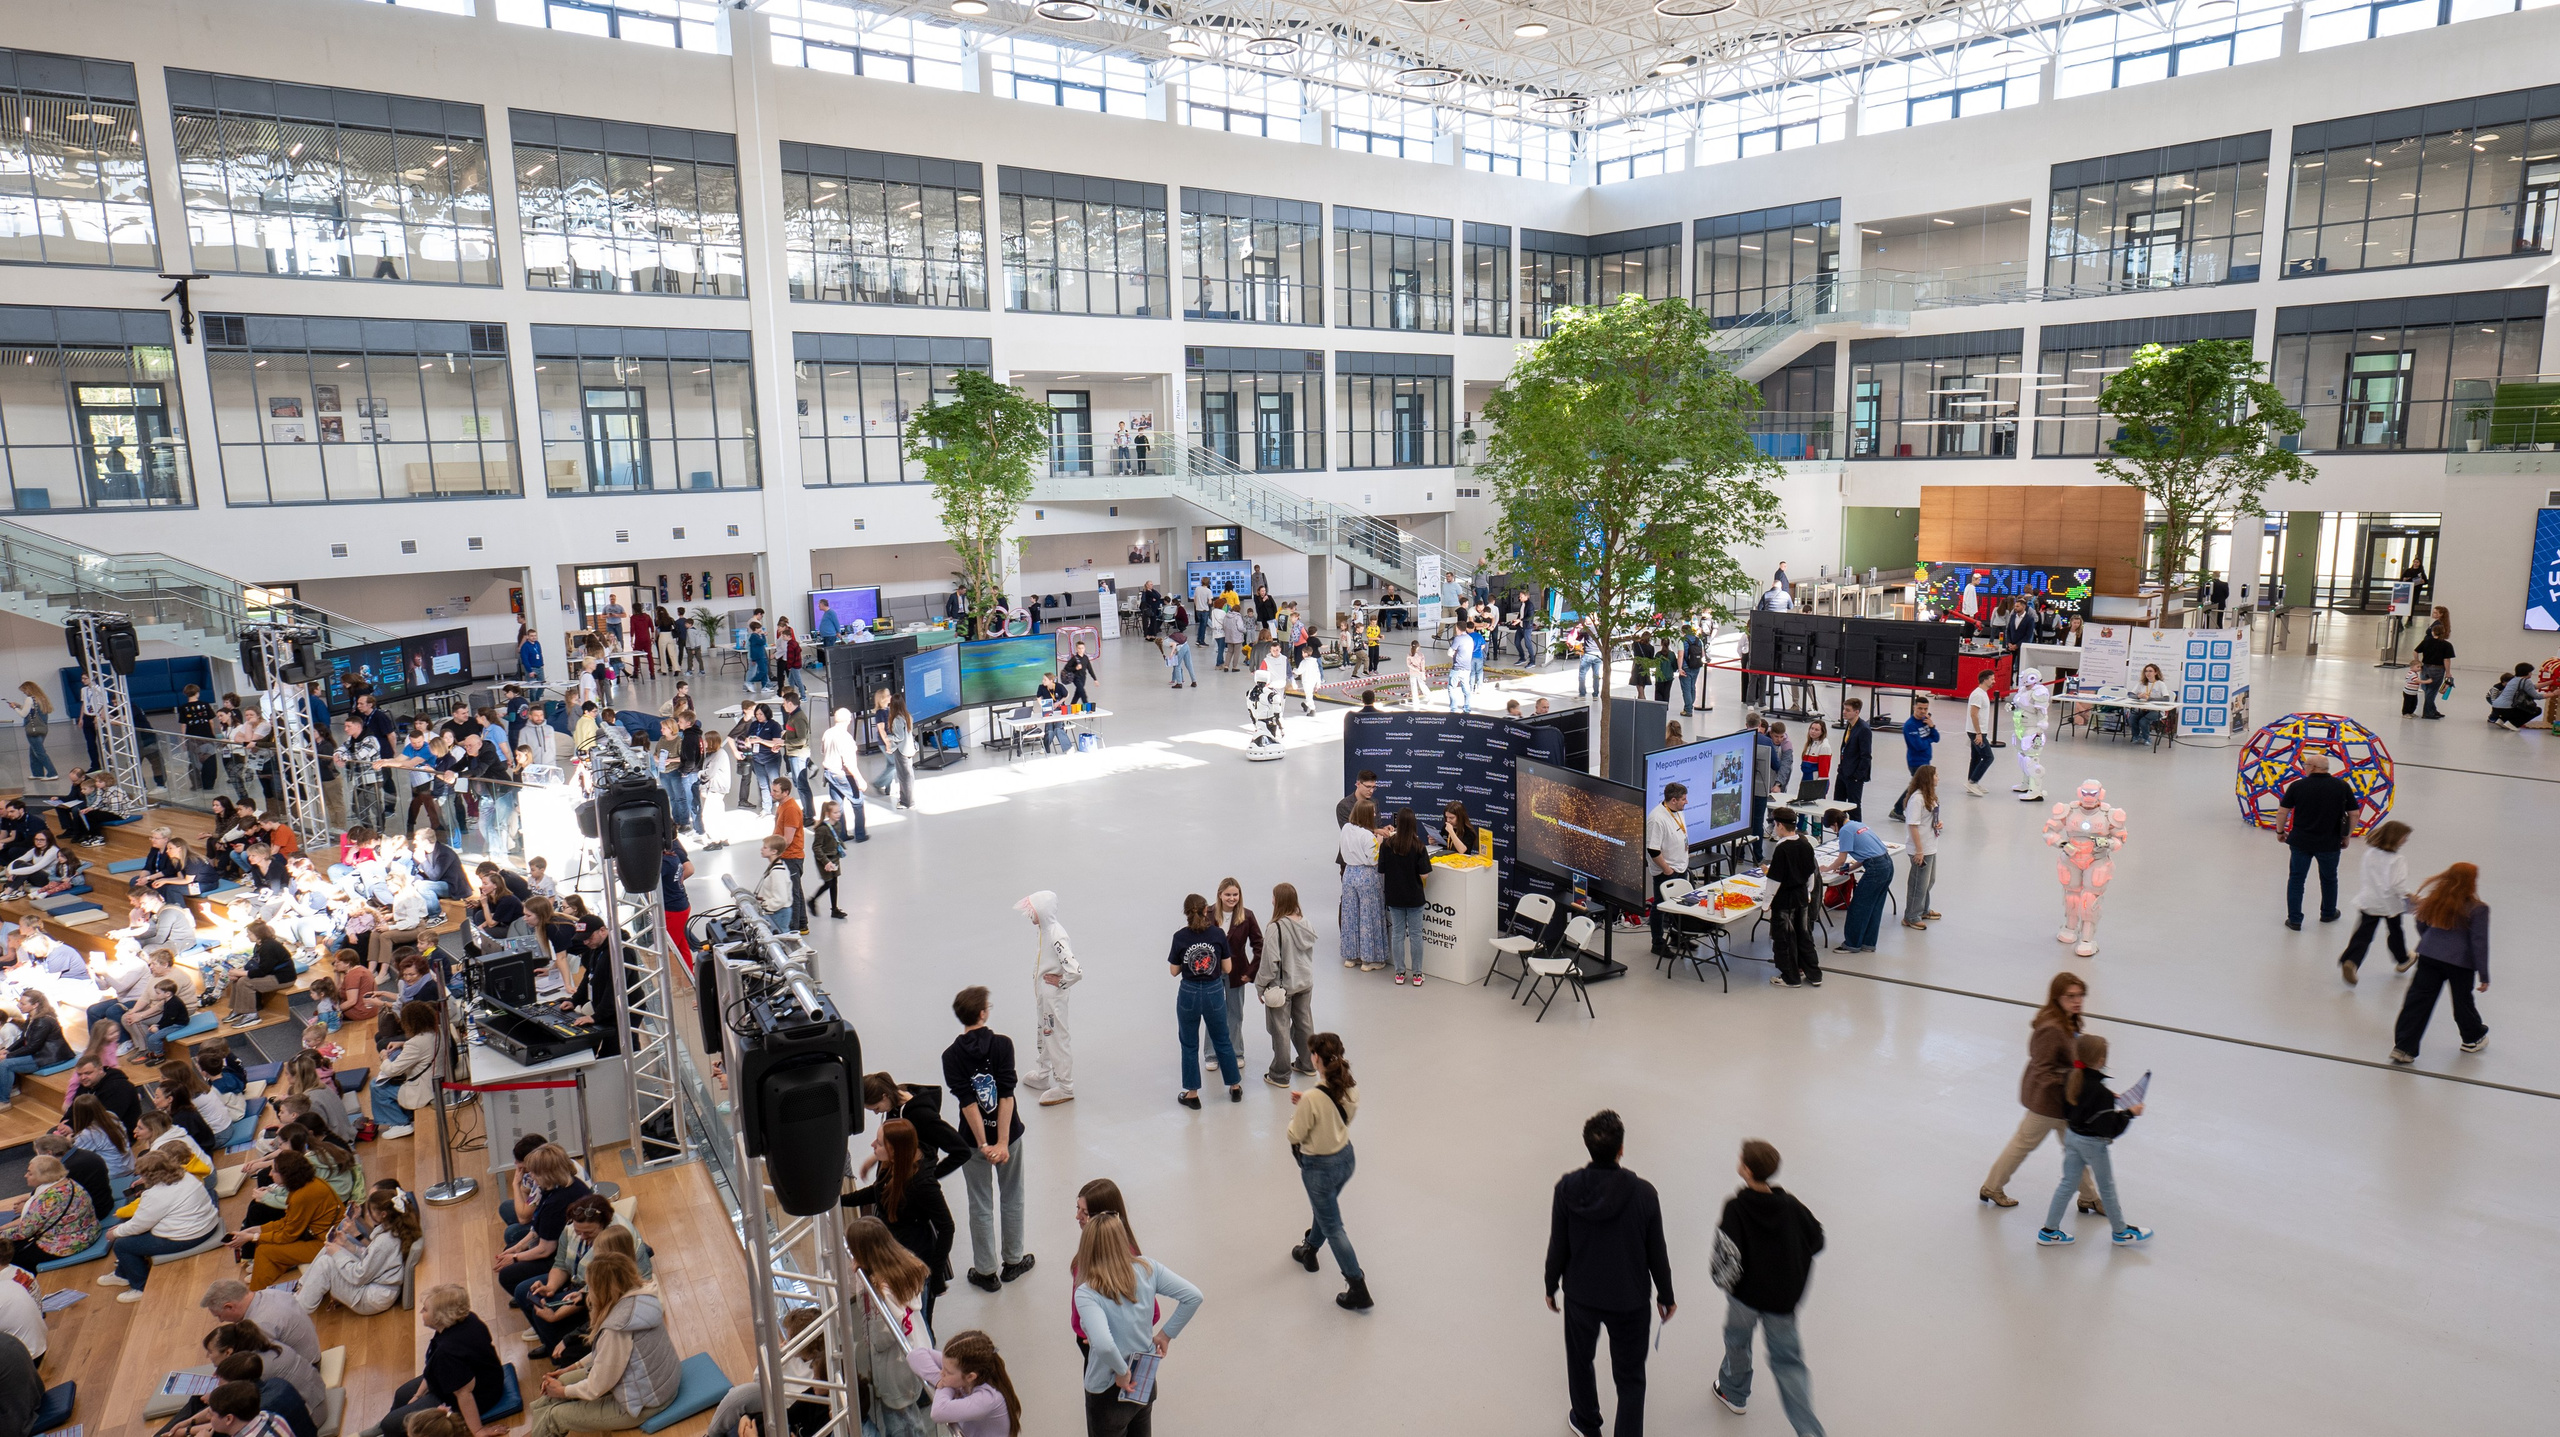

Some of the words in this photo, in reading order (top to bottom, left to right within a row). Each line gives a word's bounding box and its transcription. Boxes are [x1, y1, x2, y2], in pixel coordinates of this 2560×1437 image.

[1486, 738, 1509, 746] ТИНЬКОФФ
[1656, 755, 1697, 770] Мероприятия
[1699, 750, 1712, 759] ФКН
[1486, 771, 1509, 779] ТИНЬКОФФ
[1485, 804, 1509, 812] ТИНЬКОФФ
[1558, 820, 1597, 837] Искусственный
[1424, 901, 1456, 916] ОФФ
[1423, 914, 1452, 928] ВАНИЕ
[1422, 928, 1457, 942] АЛЬНЫЙ
[1422, 936, 1454, 949] РСИТЕТ
